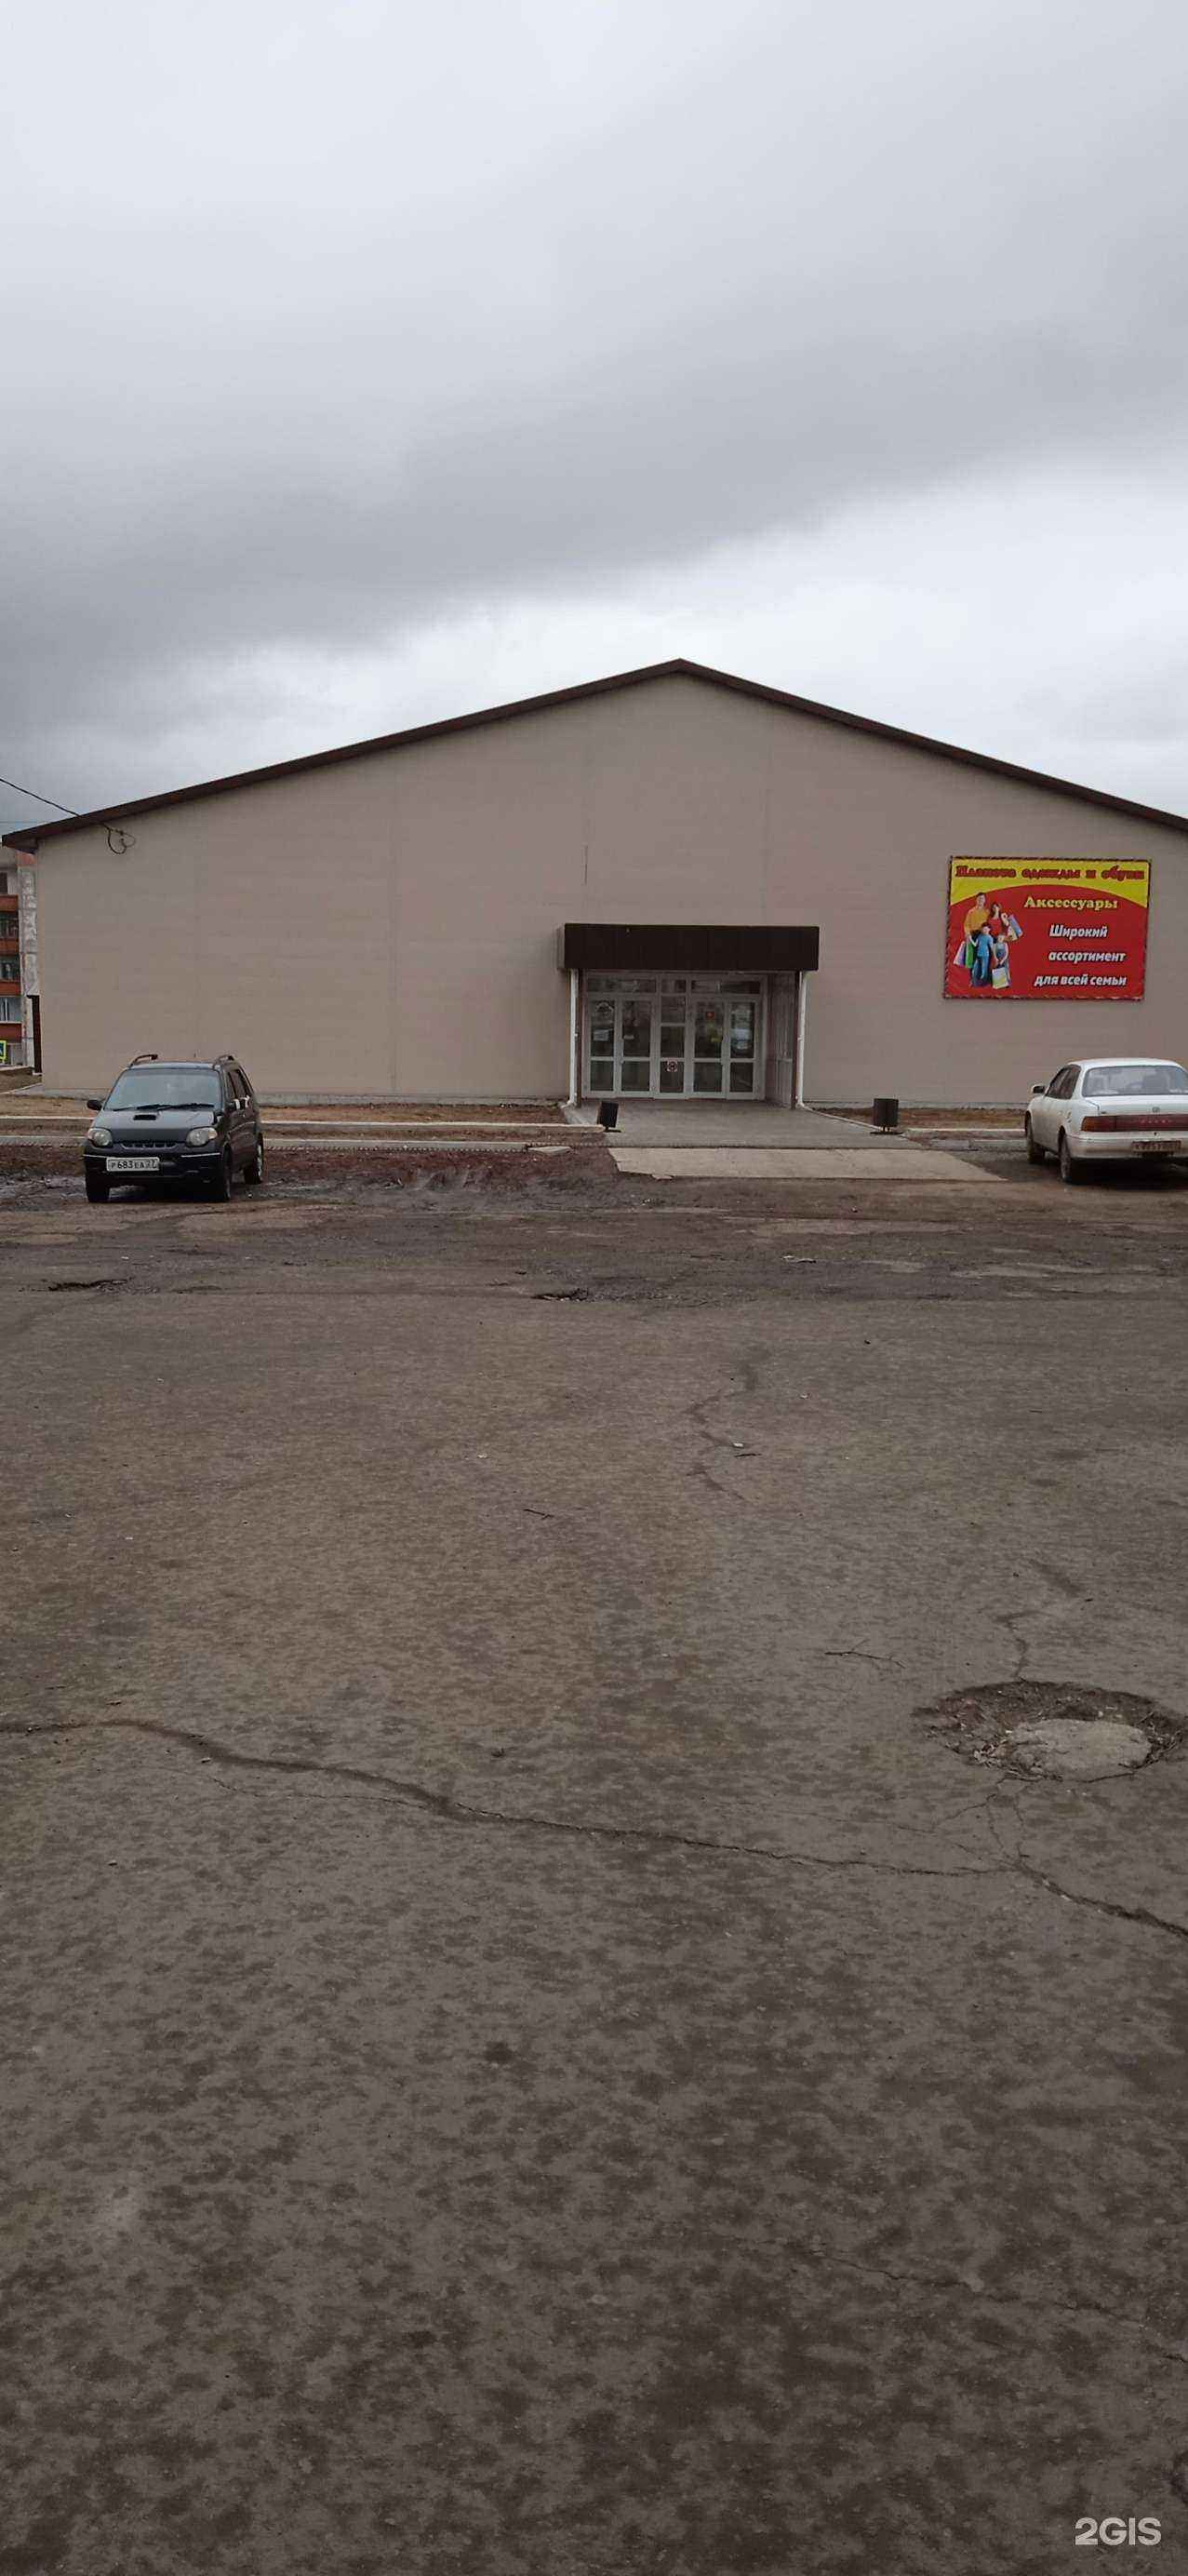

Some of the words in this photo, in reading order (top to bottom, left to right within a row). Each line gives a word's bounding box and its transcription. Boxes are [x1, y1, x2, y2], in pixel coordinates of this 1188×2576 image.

[1024, 896, 1117, 910] Аксессуары
[1048, 924, 1108, 940] Широкий
[1048, 951, 1126, 963] ассортимент
[1034, 975, 1059, 986] для
[1061, 973, 1088, 986] всей
[1089, 975, 1127, 986] семьи
